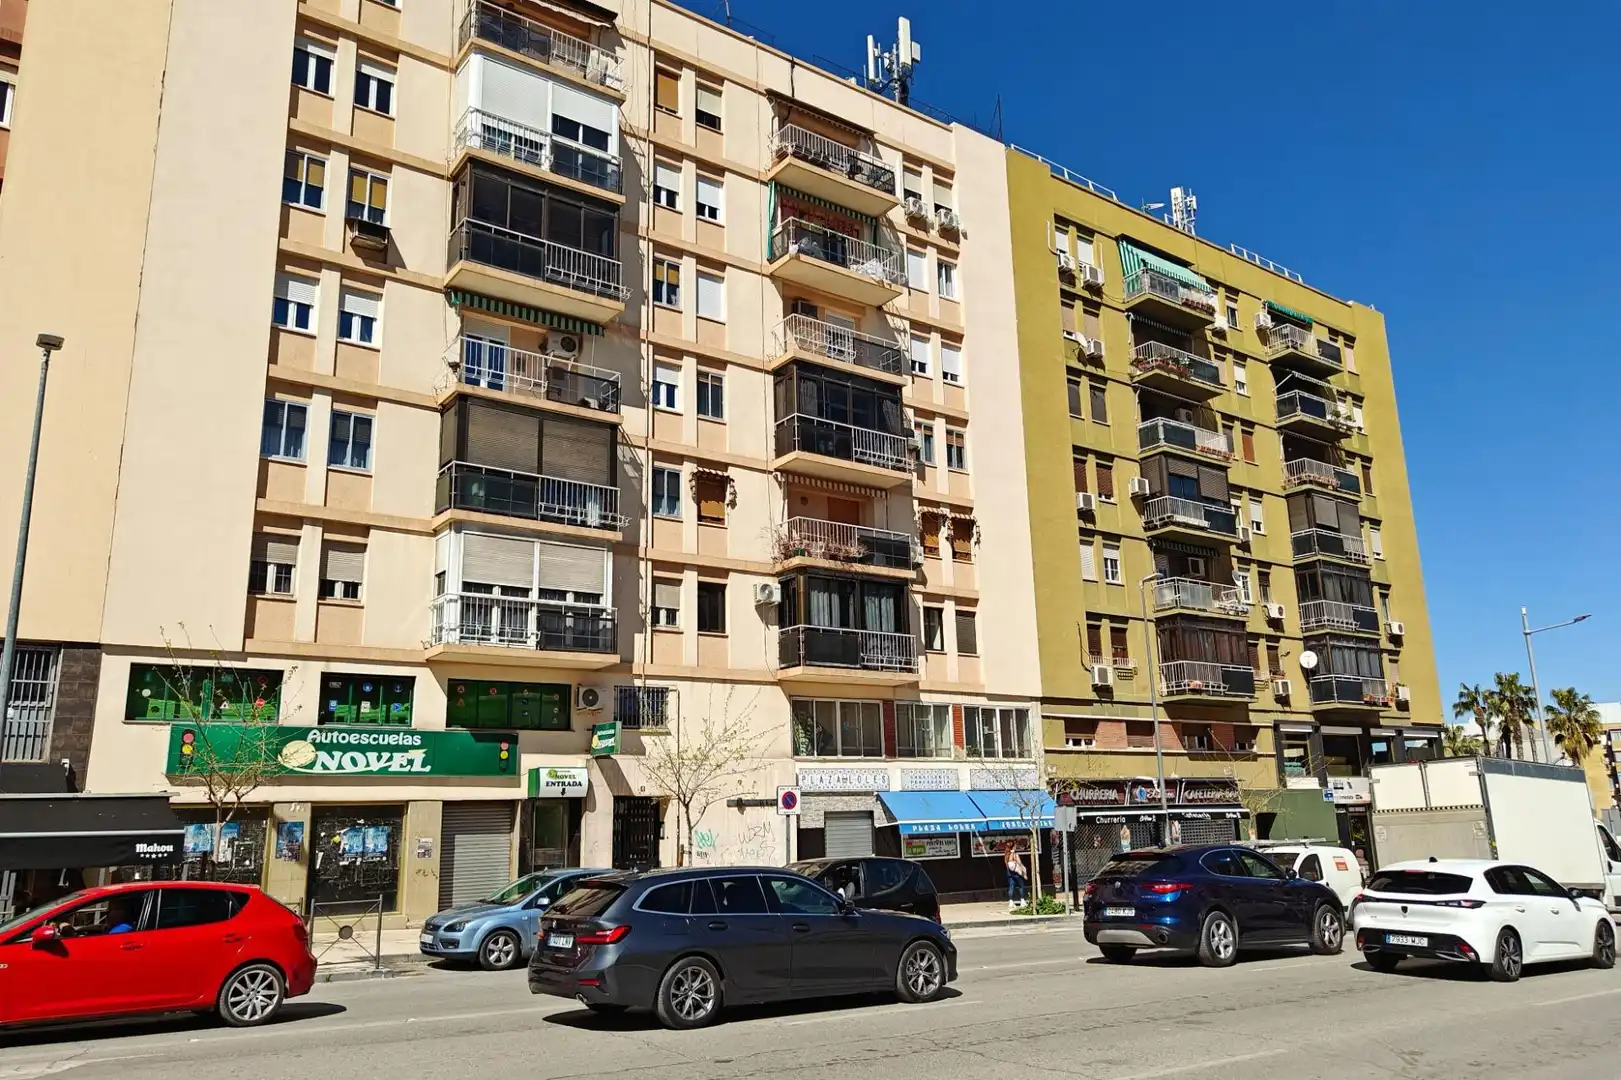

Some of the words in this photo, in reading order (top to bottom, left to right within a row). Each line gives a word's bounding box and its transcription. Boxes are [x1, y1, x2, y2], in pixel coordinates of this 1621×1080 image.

[306, 729, 422, 746] Autoescuelas
[312, 750, 431, 772] NOVEL
[801, 775, 840, 784] PLAZA
[849, 775, 886, 784] LOLES
[1070, 787, 1119, 800] CHURRERIA
[912, 824, 941, 832] PLAZA
[135, 843, 174, 853] Mahou
